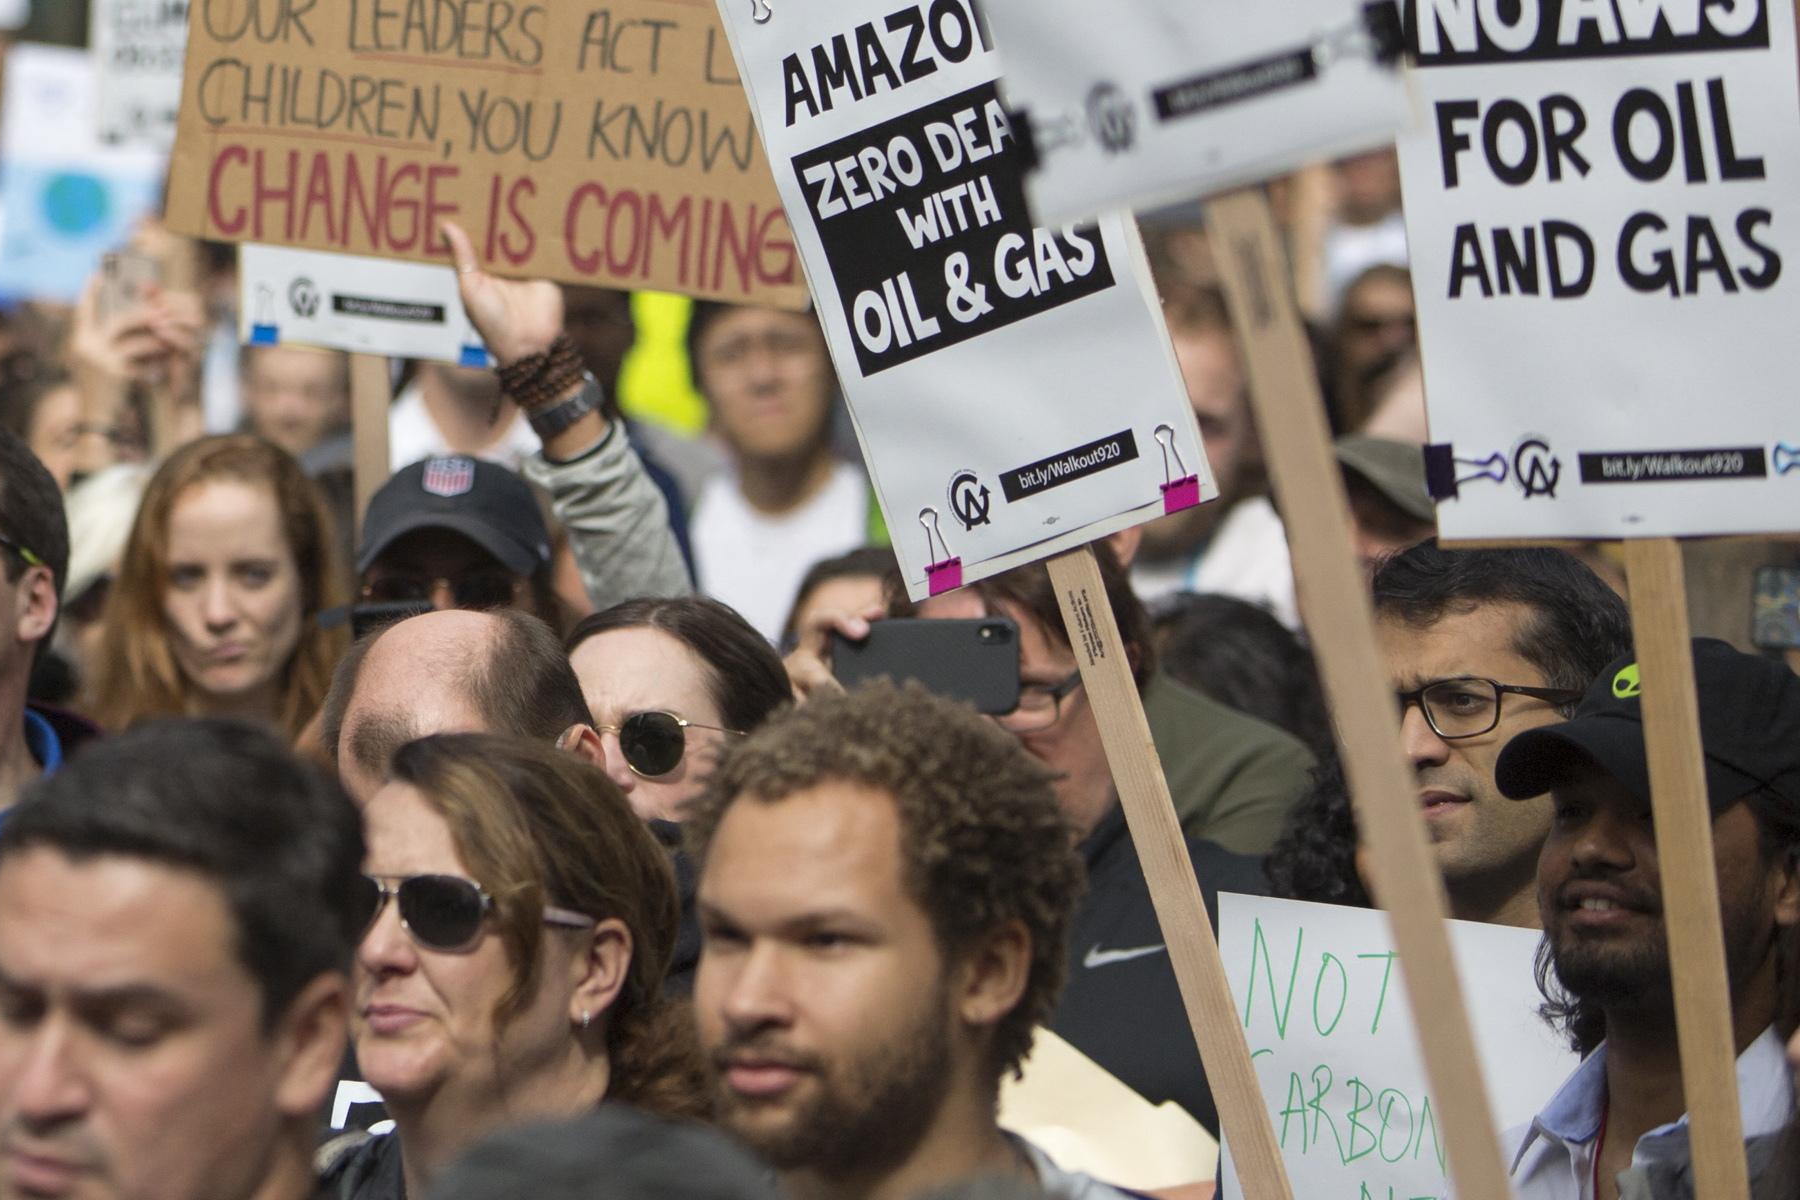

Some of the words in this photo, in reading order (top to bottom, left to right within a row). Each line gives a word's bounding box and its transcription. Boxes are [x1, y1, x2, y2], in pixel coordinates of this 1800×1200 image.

[577, 8, 678, 76] ACT
[705, 27, 743, 85] L
[458, 87, 562, 162] YOU
[586, 99, 755, 172] KNOW
[802, 135, 923, 220] ZERO
[923, 98, 1015, 174] DEA
[1433, 94, 1591, 189] FOR
[1611, 77, 1767, 185] OIL
[206, 144, 460, 255] CHANGE
[484, 174, 537, 265] IS
[564, 180, 797, 294] COMING
[895, 174, 1003, 250] WITH
[1447, 220, 1596, 299] AND
[1616, 208, 1782, 298] GAS
[852, 270, 942, 354] OIL
[944, 251, 995, 324] &
[994, 220, 1096, 299] GAS
[1018, 441, 1120, 489] bit.ly/Walkout920
[1602, 452, 1743, 480] bit.ly/Walkout920
[1245, 917, 1401, 1041] NOT
[1251, 1048, 1446, 1179] ARBON
